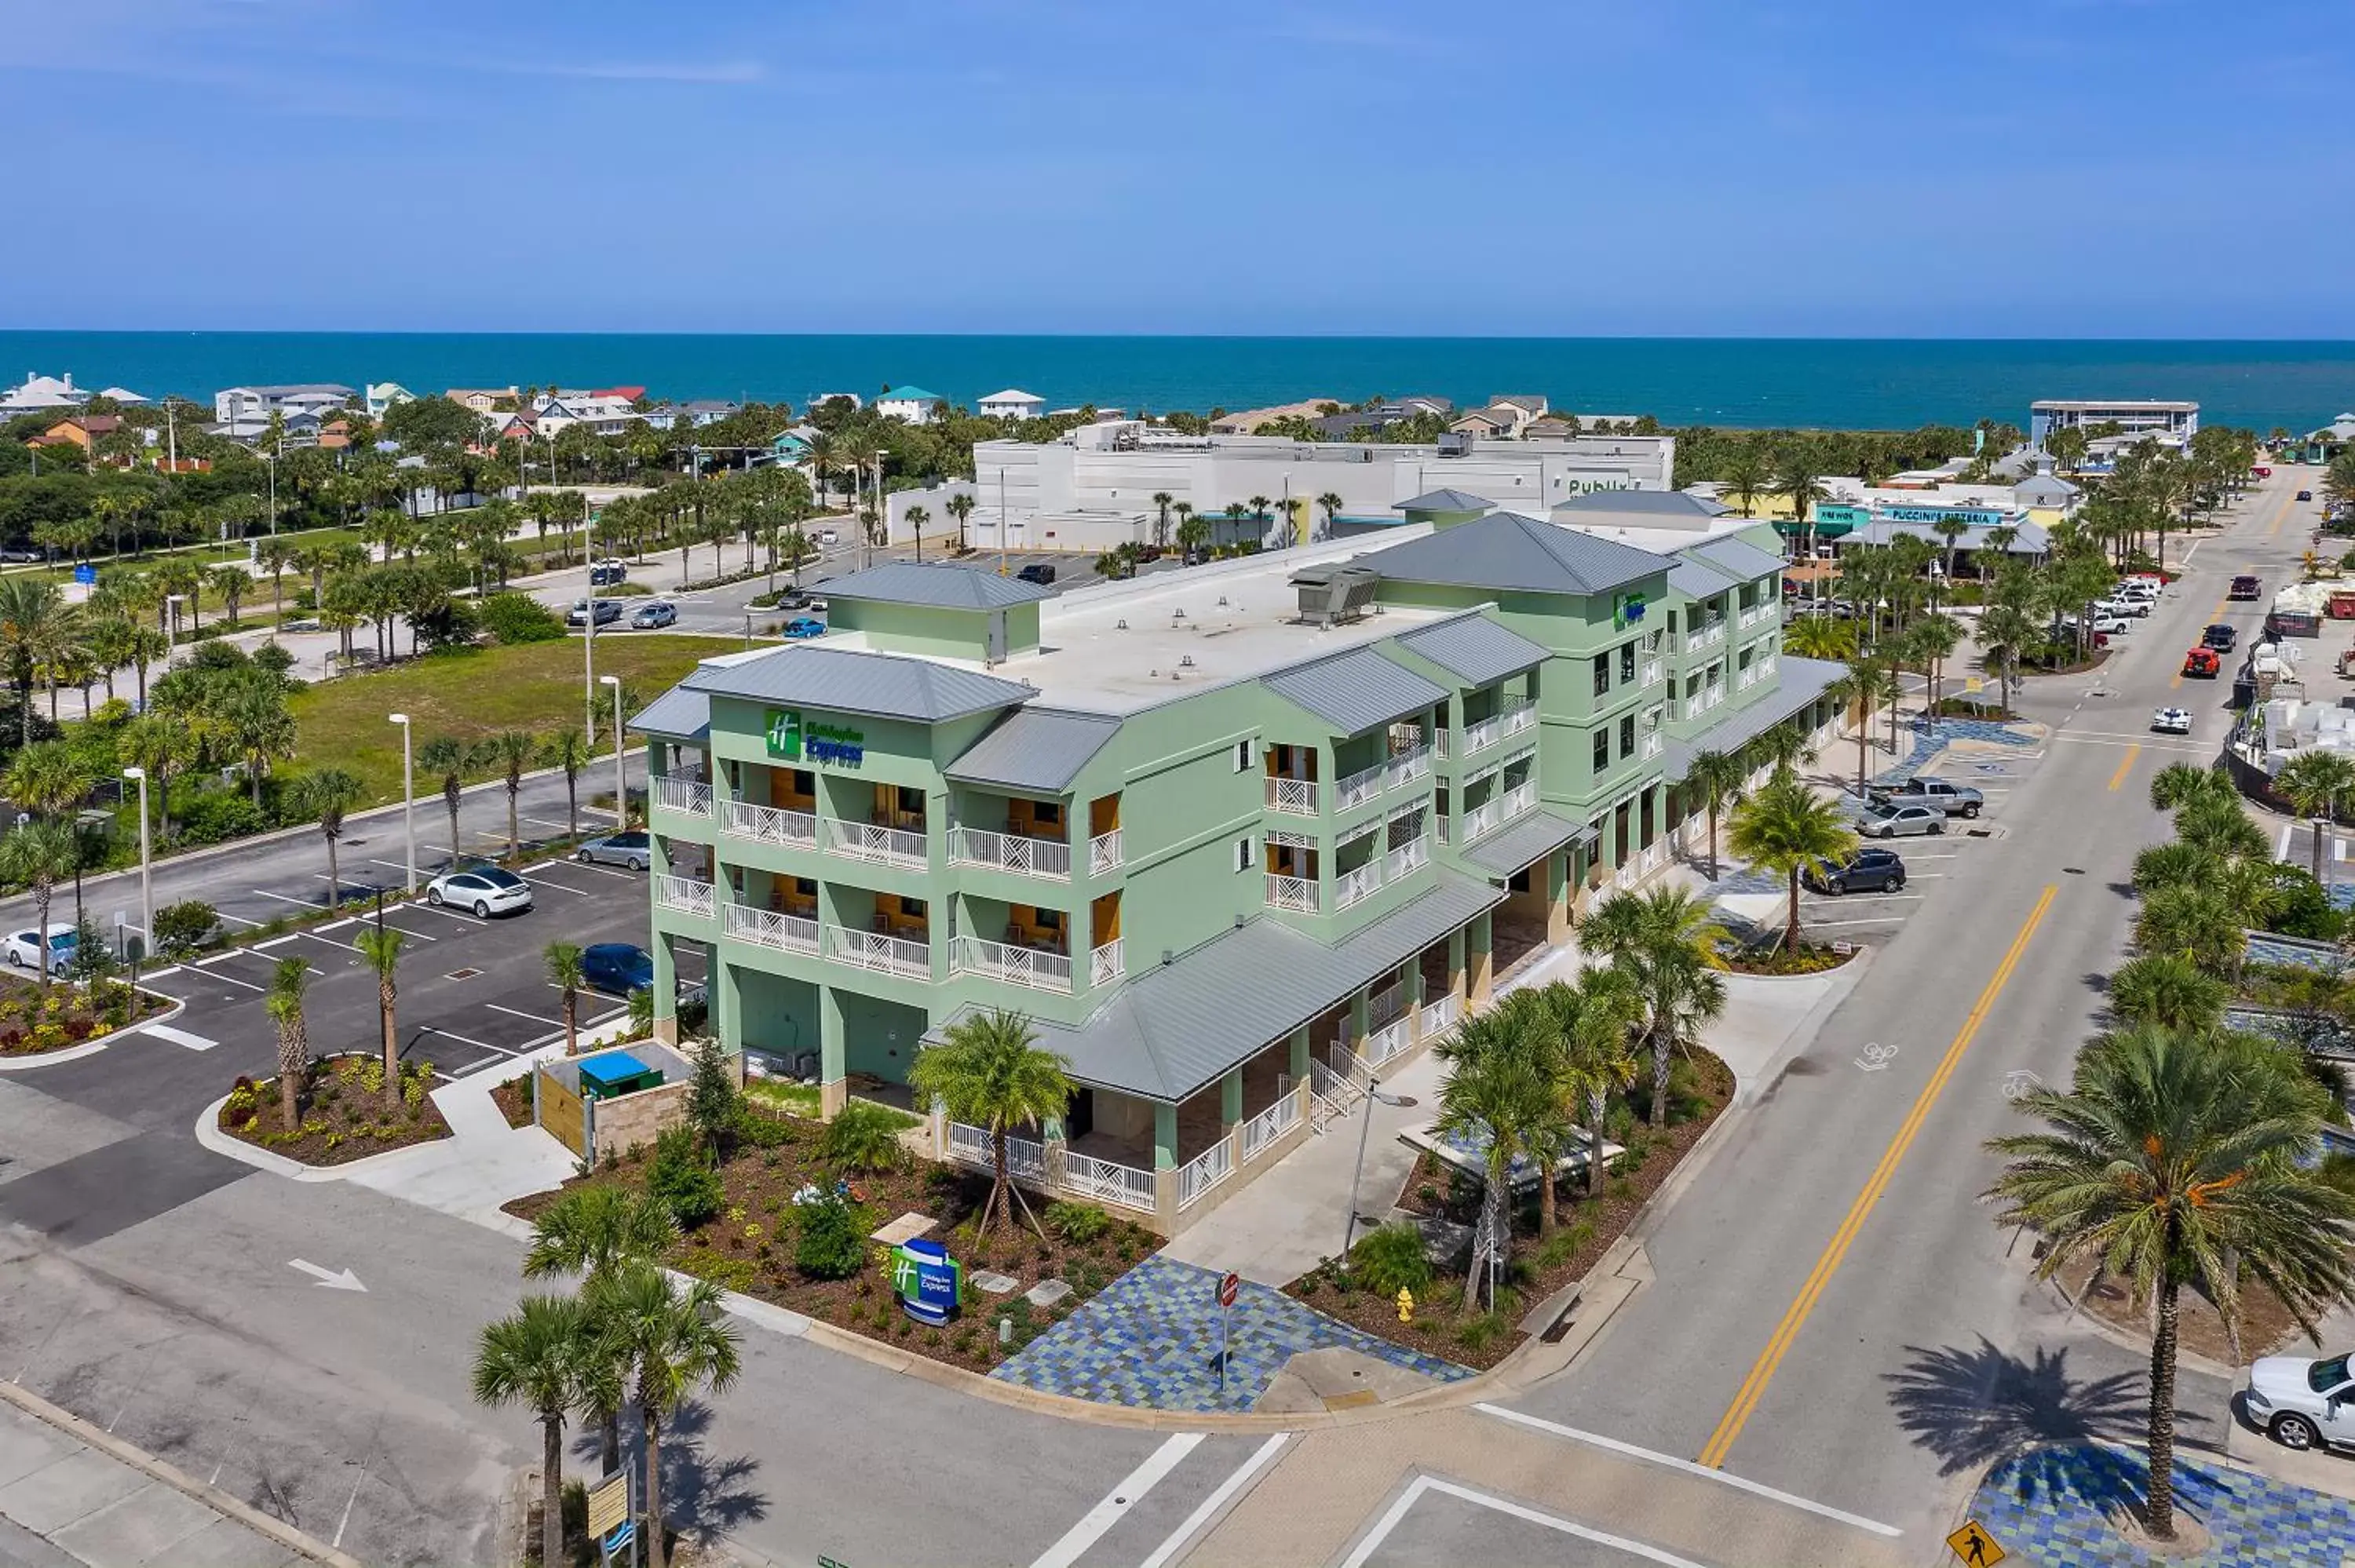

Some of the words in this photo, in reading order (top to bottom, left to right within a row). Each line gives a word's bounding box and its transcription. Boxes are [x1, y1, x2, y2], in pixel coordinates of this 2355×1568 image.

[1569, 480, 1627, 494] Publix
[1893, 510, 1941, 521] PUCCINI'S
[1945, 512, 1989, 523] PIZZERIA
[806, 735, 864, 762] Express
[921, 1279, 951, 1293] Express
